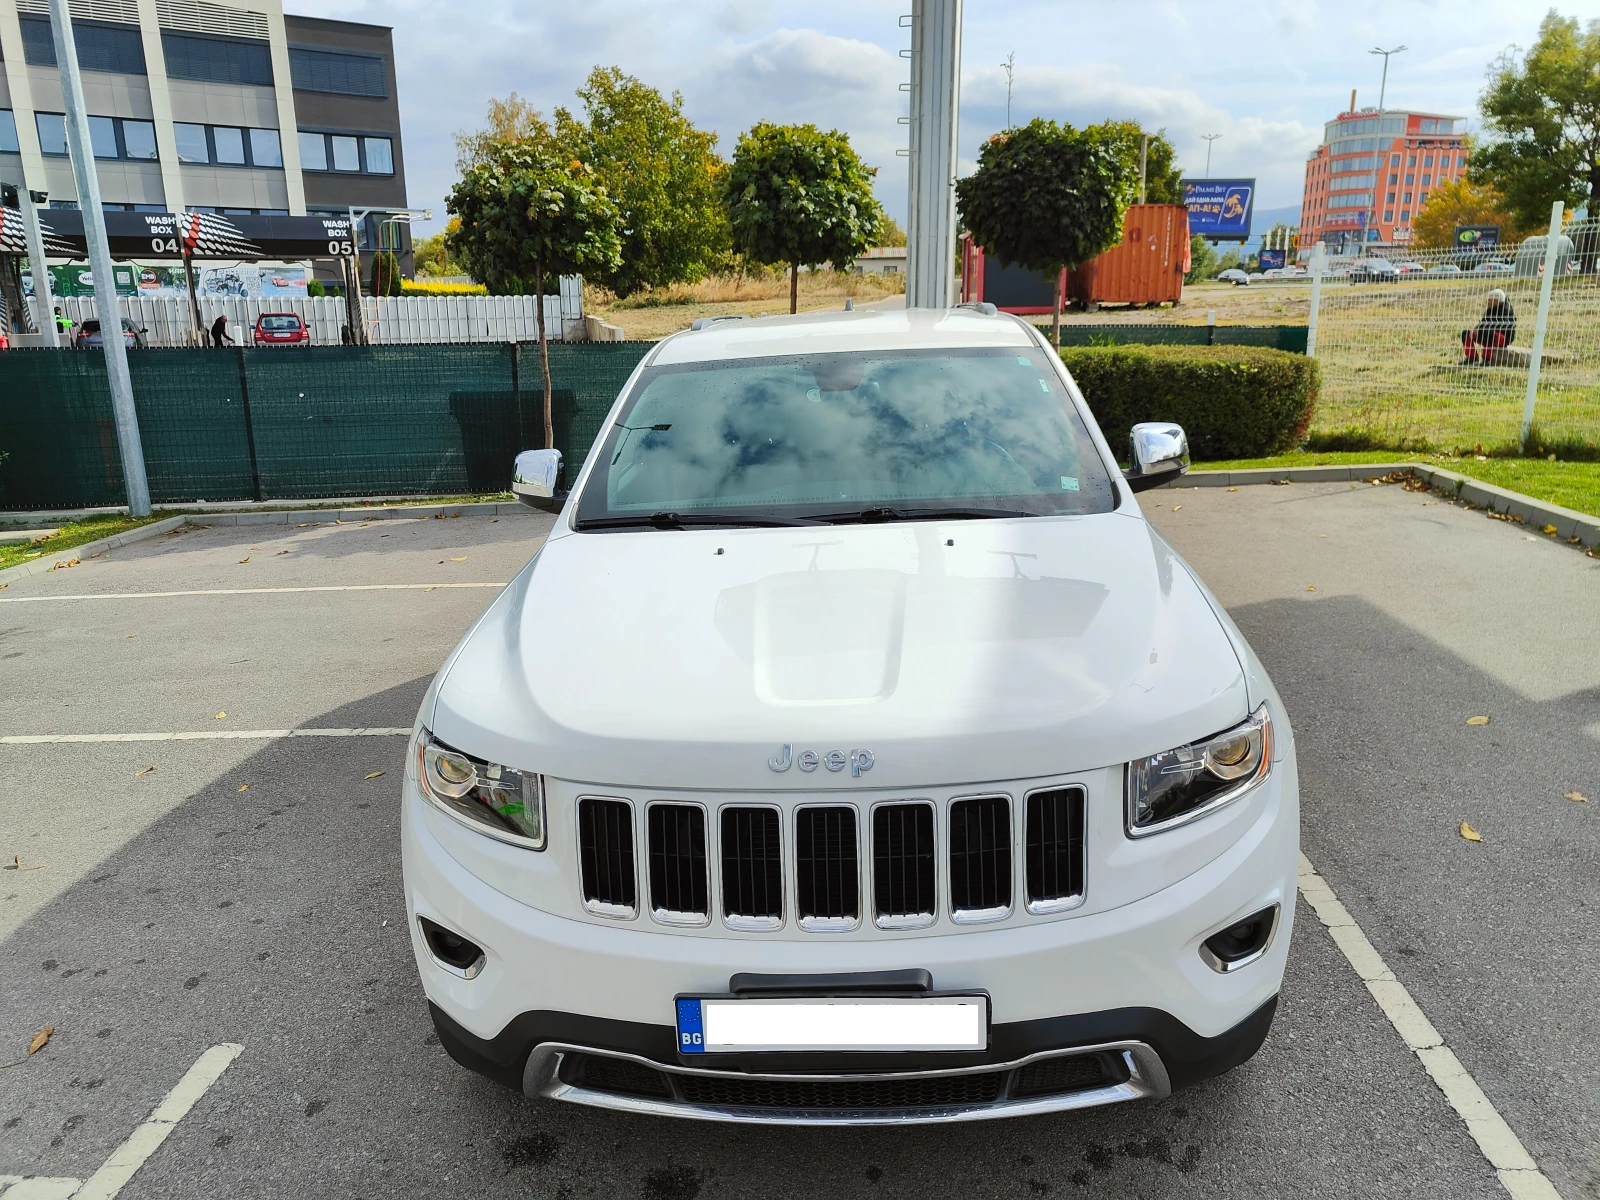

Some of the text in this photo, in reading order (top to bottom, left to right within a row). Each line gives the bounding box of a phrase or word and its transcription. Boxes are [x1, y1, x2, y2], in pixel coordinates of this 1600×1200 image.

[145, 216, 176, 225] WASH
[322, 220, 350, 228] WASH
[150, 226, 173, 234] BOX
[327, 229, 348, 237] BOX
[151, 238, 179, 253] 04
[328, 241, 352, 255] 05
[768, 743, 875, 778] Jeep
[681, 1032, 702, 1045] BG
